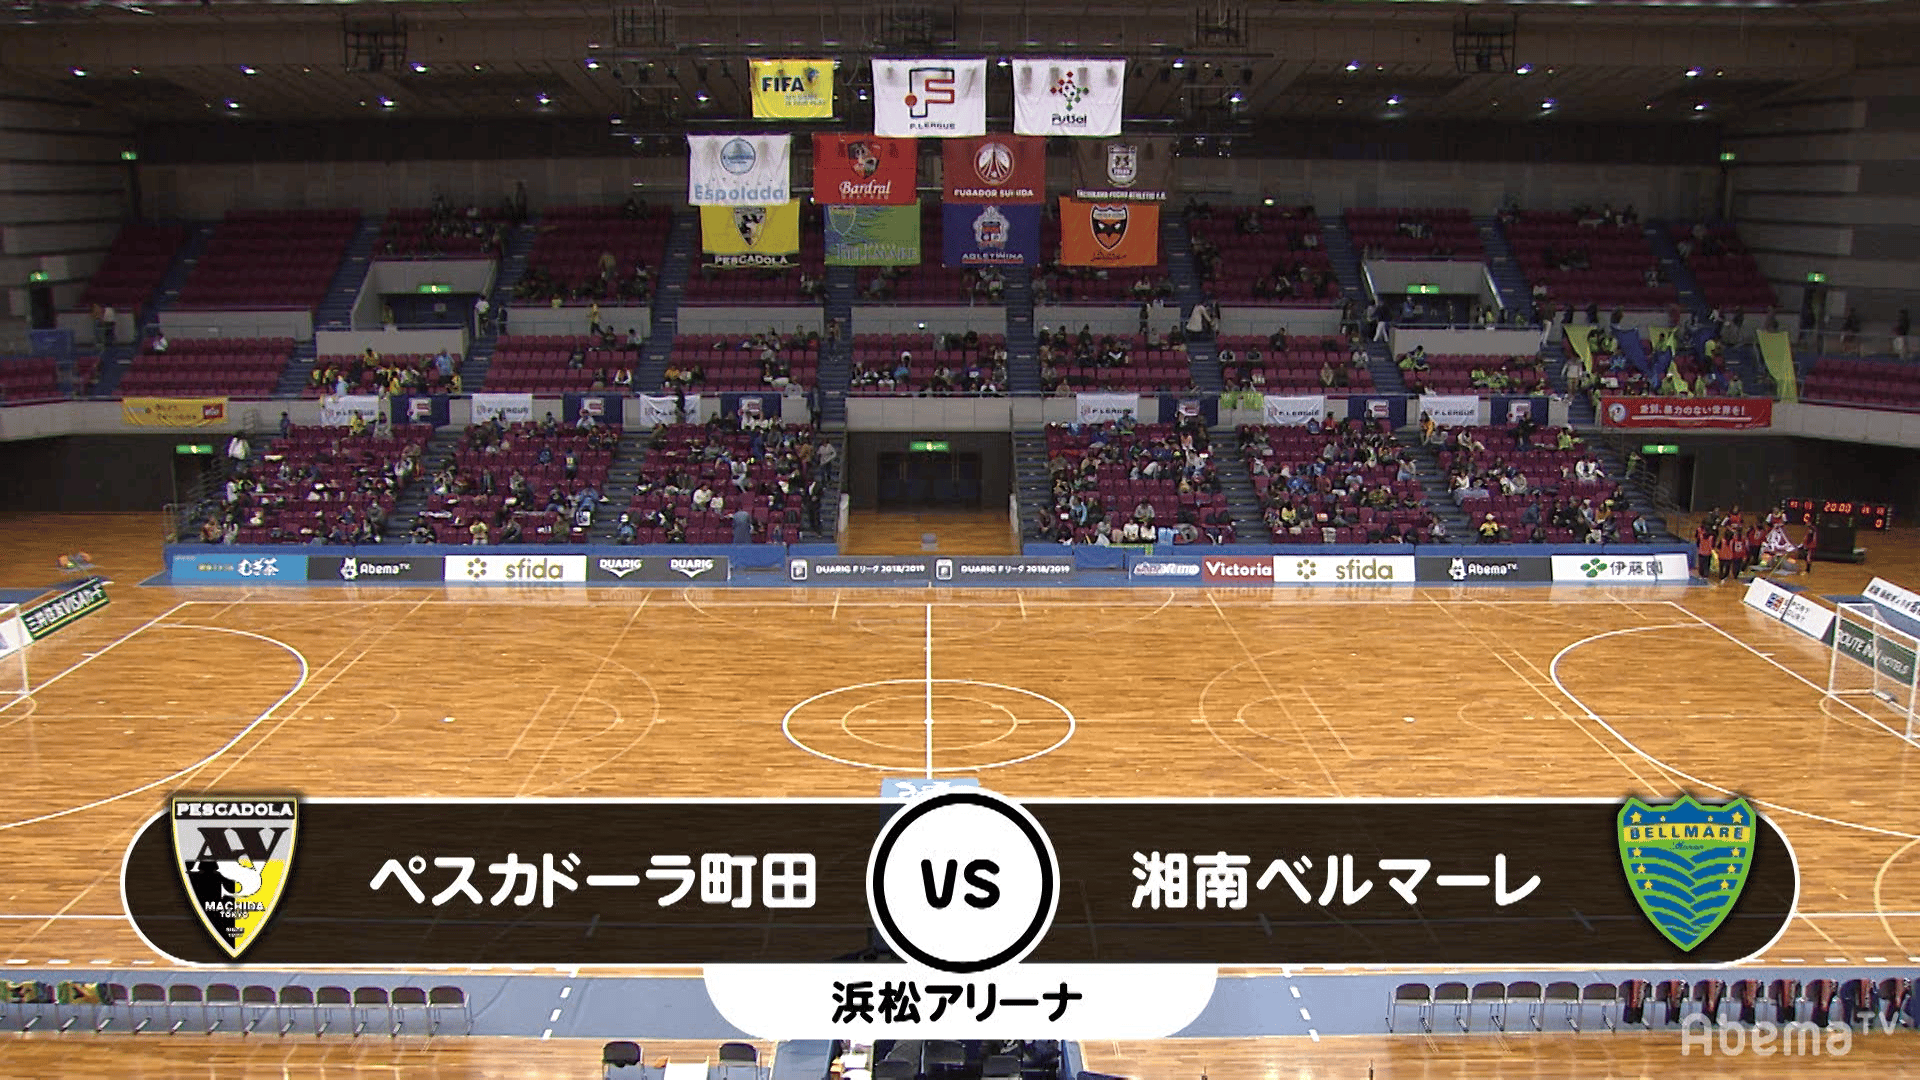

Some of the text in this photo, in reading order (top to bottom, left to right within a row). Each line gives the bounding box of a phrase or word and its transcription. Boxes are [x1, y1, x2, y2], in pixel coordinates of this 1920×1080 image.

[761, 77, 805, 92] FIFA
[694, 184, 784, 202] Espolada
[954, 188, 997, 198] FUGADOR
[505, 558, 564, 580] sfida
[600, 558, 714, 569] DUARIG DUARIG
[1205, 560, 1273, 577] Victoria
[1335, 558, 1394, 580] sfida
